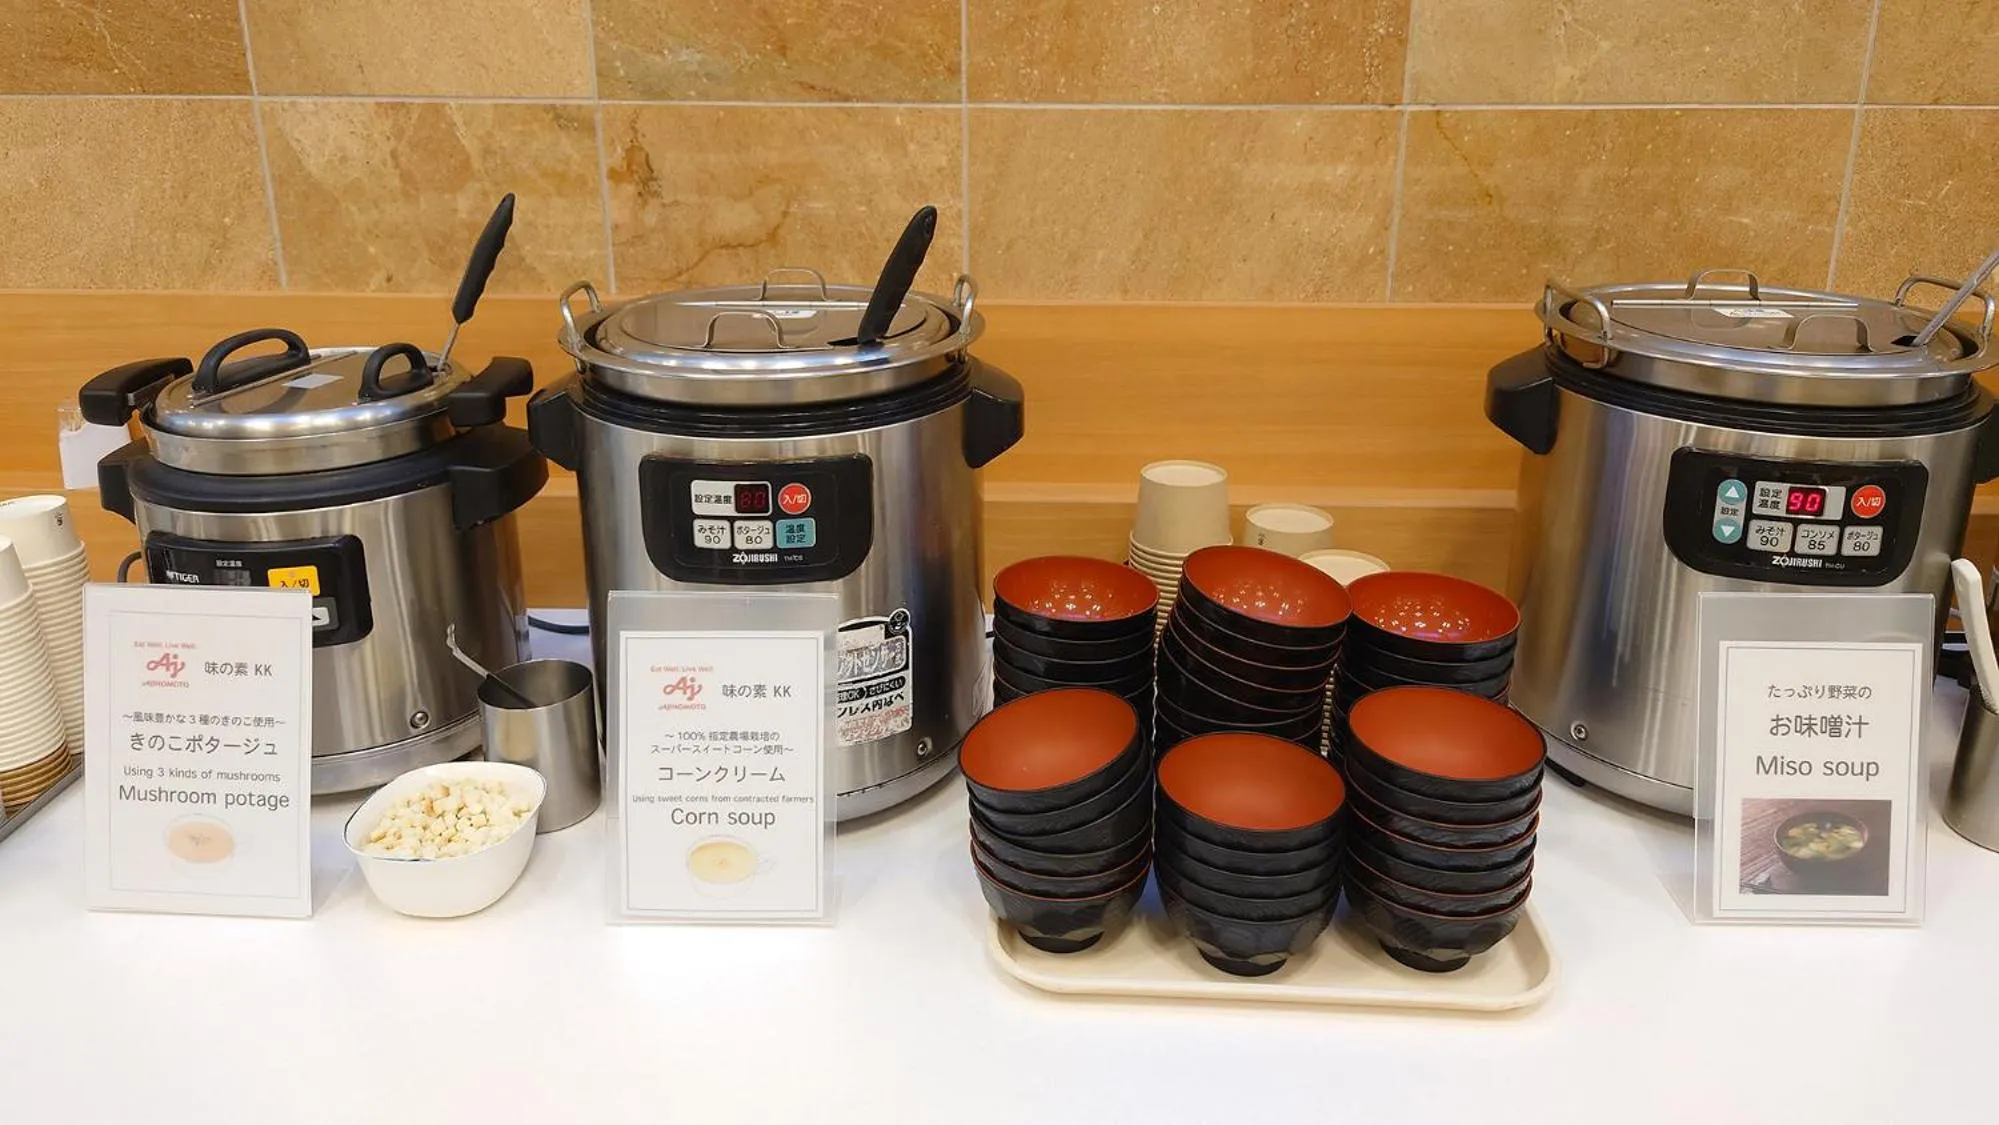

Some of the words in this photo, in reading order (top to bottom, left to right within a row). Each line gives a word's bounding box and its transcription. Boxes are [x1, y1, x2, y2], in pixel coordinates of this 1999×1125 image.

[694, 493, 732, 504] 設定温度
[1759, 488, 1782, 499] 設定
[1757, 499, 1781, 511] 温度
[1788, 492, 1822, 512] 90
[1720, 507, 1739, 516] 設定
[698, 525, 726, 535] みそ汁
[736, 525, 771, 535] ポタージュ
[785, 524, 805, 534] 温度
[1755, 526, 1786, 537] みそ汁
[1801, 530, 1835, 539] コンソメ
[704, 535, 721, 544] 90
[745, 535, 763, 545] 80
[786, 534, 806, 544] 設定
[1759, 536, 1779, 547] 90
[1846, 531, 1879, 541] ポタージュ
[1807, 540, 1826, 551] 85
[1853, 542, 1870, 551] 80
[732, 552, 778, 565] ZOJIRUSHI
[1772, 555, 1823, 568] ZOJIRUSHI
[172, 571, 200, 584] TIGER
[204, 661, 249, 677] 味の素
[254, 664, 273, 677] KK
[721, 683, 767, 699] 味の素
[773, 685, 792, 698] KK
[1768, 684, 1872, 700] たっぷり野菜の
[1769, 714, 1870, 739] お味噌汁
[130, 732, 278, 756] きのこポタージュ
[123, 766, 153, 779] Using
[158, 767, 165, 777] 3
[169, 768, 198, 779] kinds
[201, 769, 213, 779] of
[216, 770, 281, 782] mushrooms
[658, 765, 786, 783] コーンクリーム
[1756, 755, 1813, 776] Miso
[1822, 760, 1880, 782] soup
[119, 784, 217, 805] Mushroom
[224, 791, 290, 812] potage
[632, 795, 655, 804] Using
[657, 795, 683, 803] sweet
[685, 795, 709, 803] corns
[711, 795, 731, 803] from
[733, 795, 779, 803] contracted
[782, 795, 815, 804] farmers
[671, 807, 719, 826] Corn
[728, 811, 776, 829] soup
